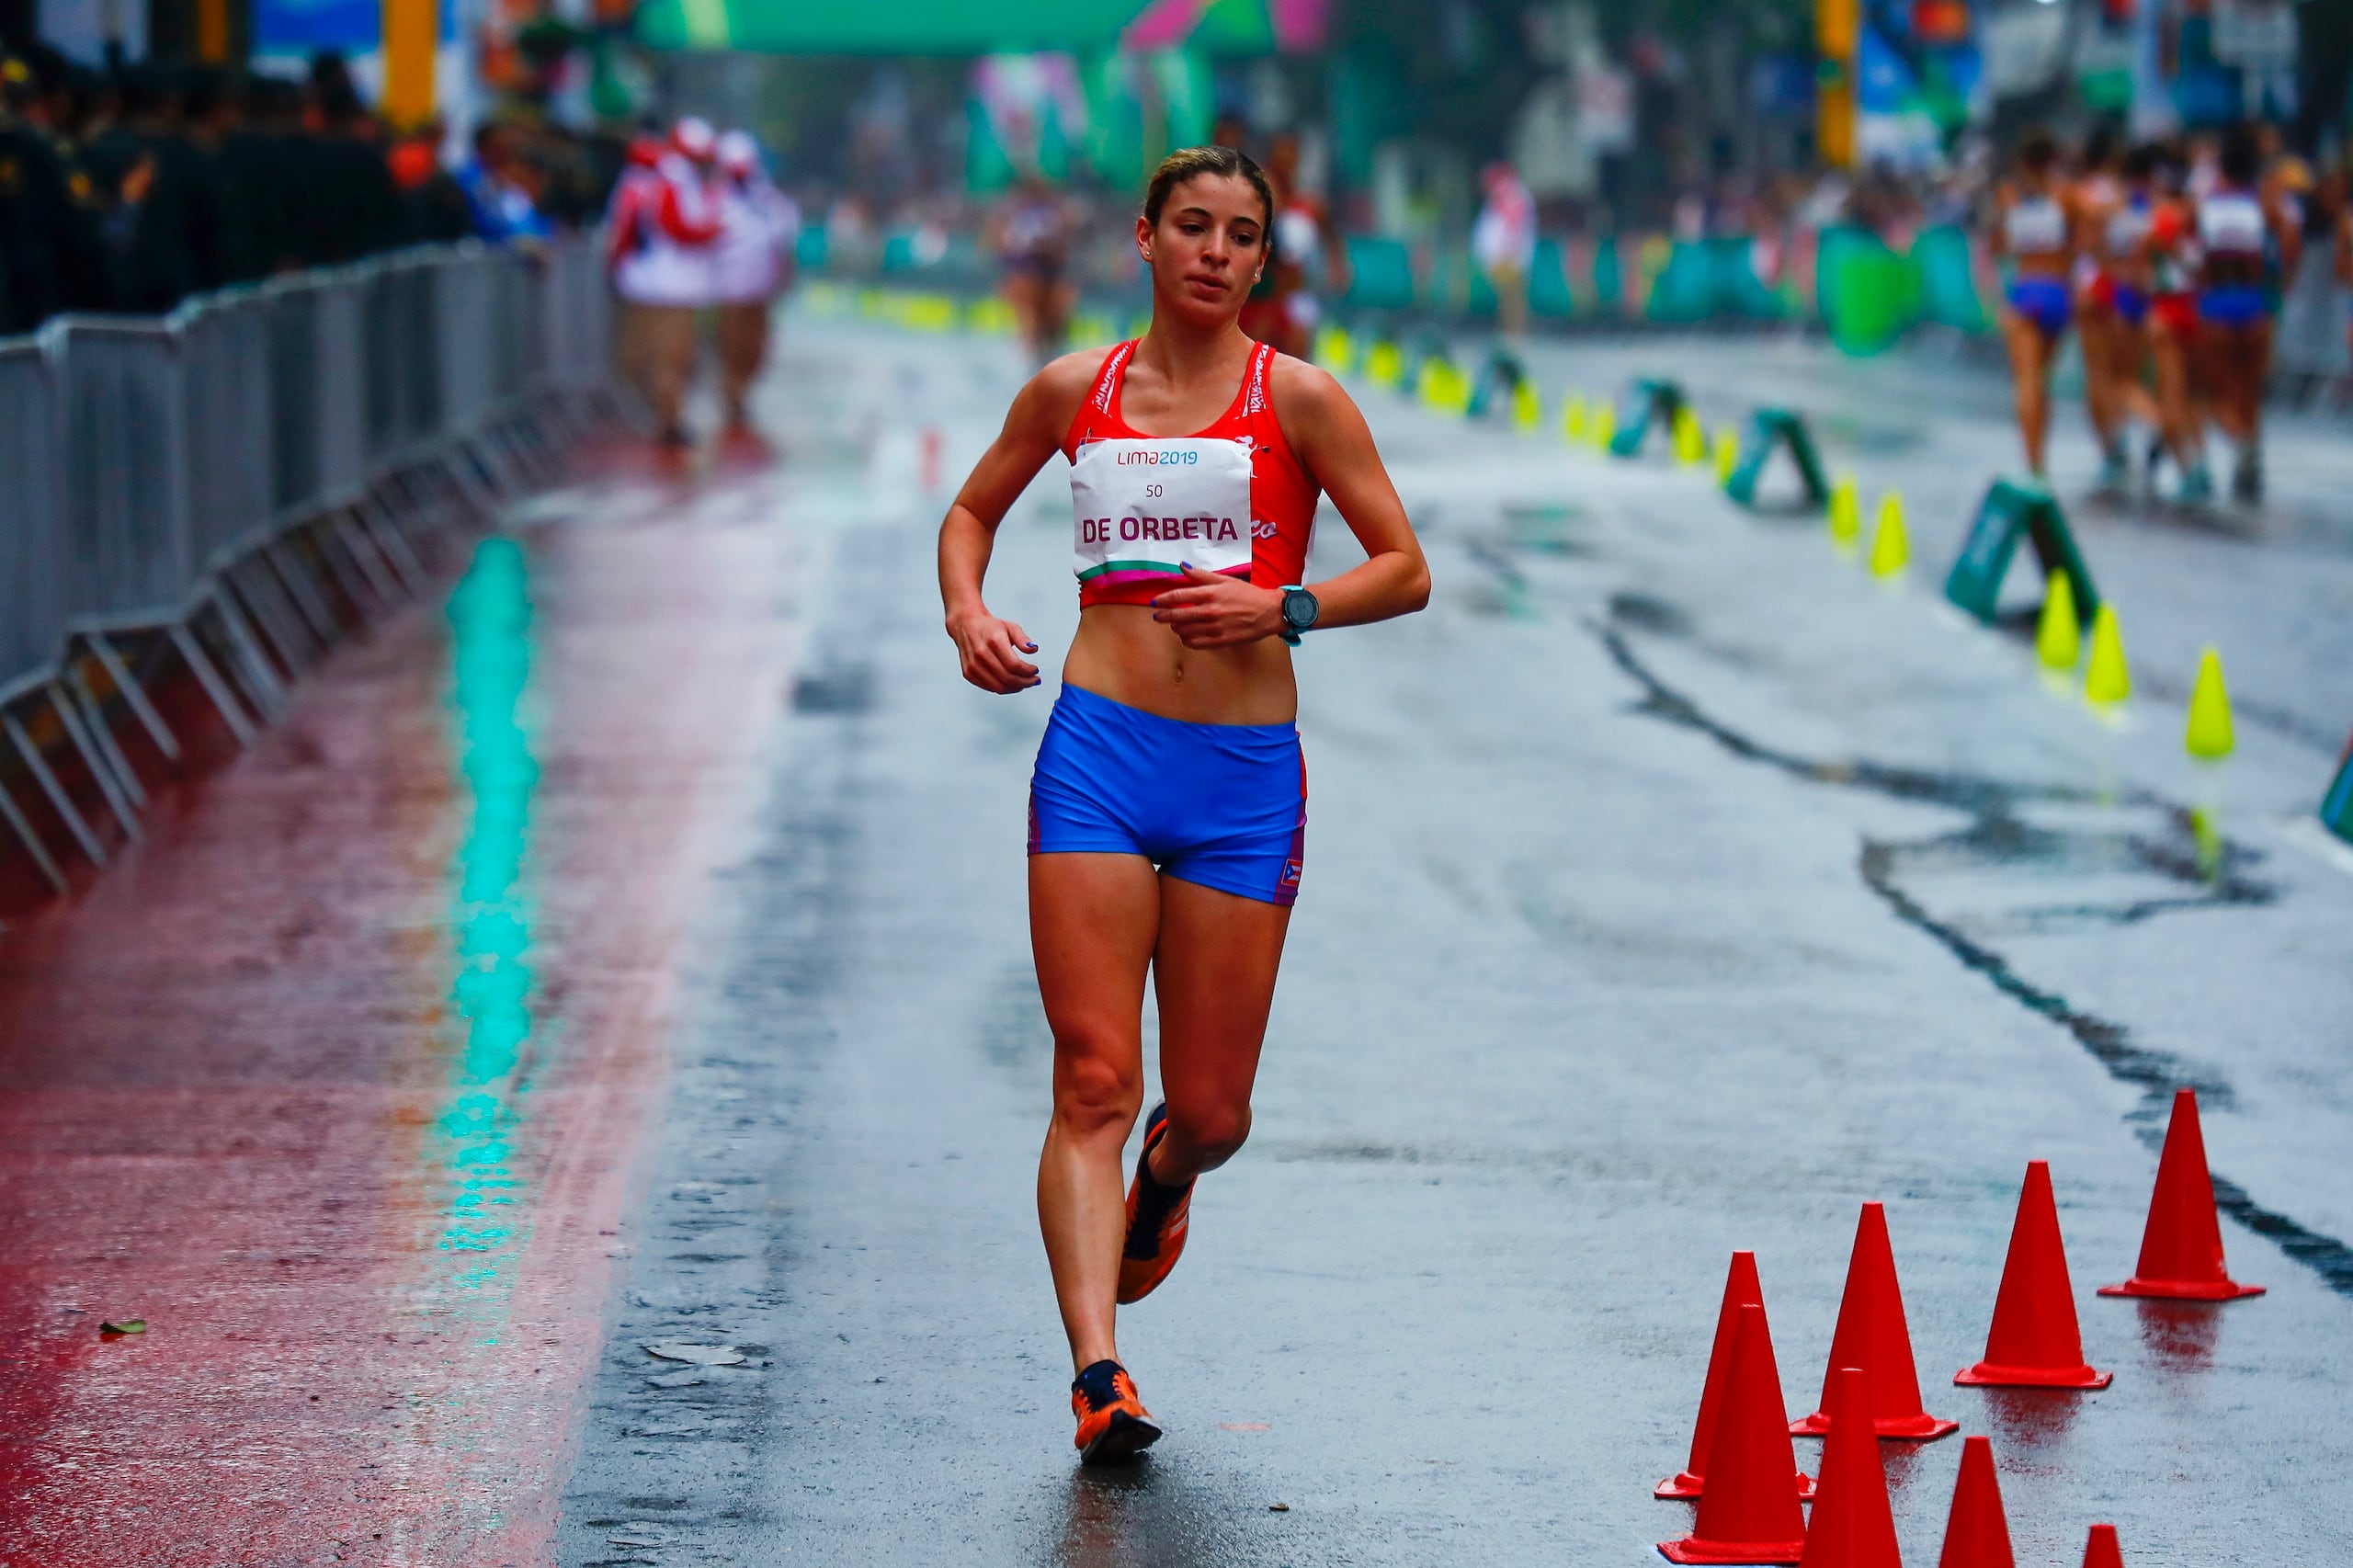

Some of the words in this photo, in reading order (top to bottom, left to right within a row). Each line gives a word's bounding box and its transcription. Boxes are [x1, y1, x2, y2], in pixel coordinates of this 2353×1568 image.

[1146, 484, 1163, 498] 50
[1083, 518, 1111, 543] DE
[1120, 517, 1239, 541] ORBETA
